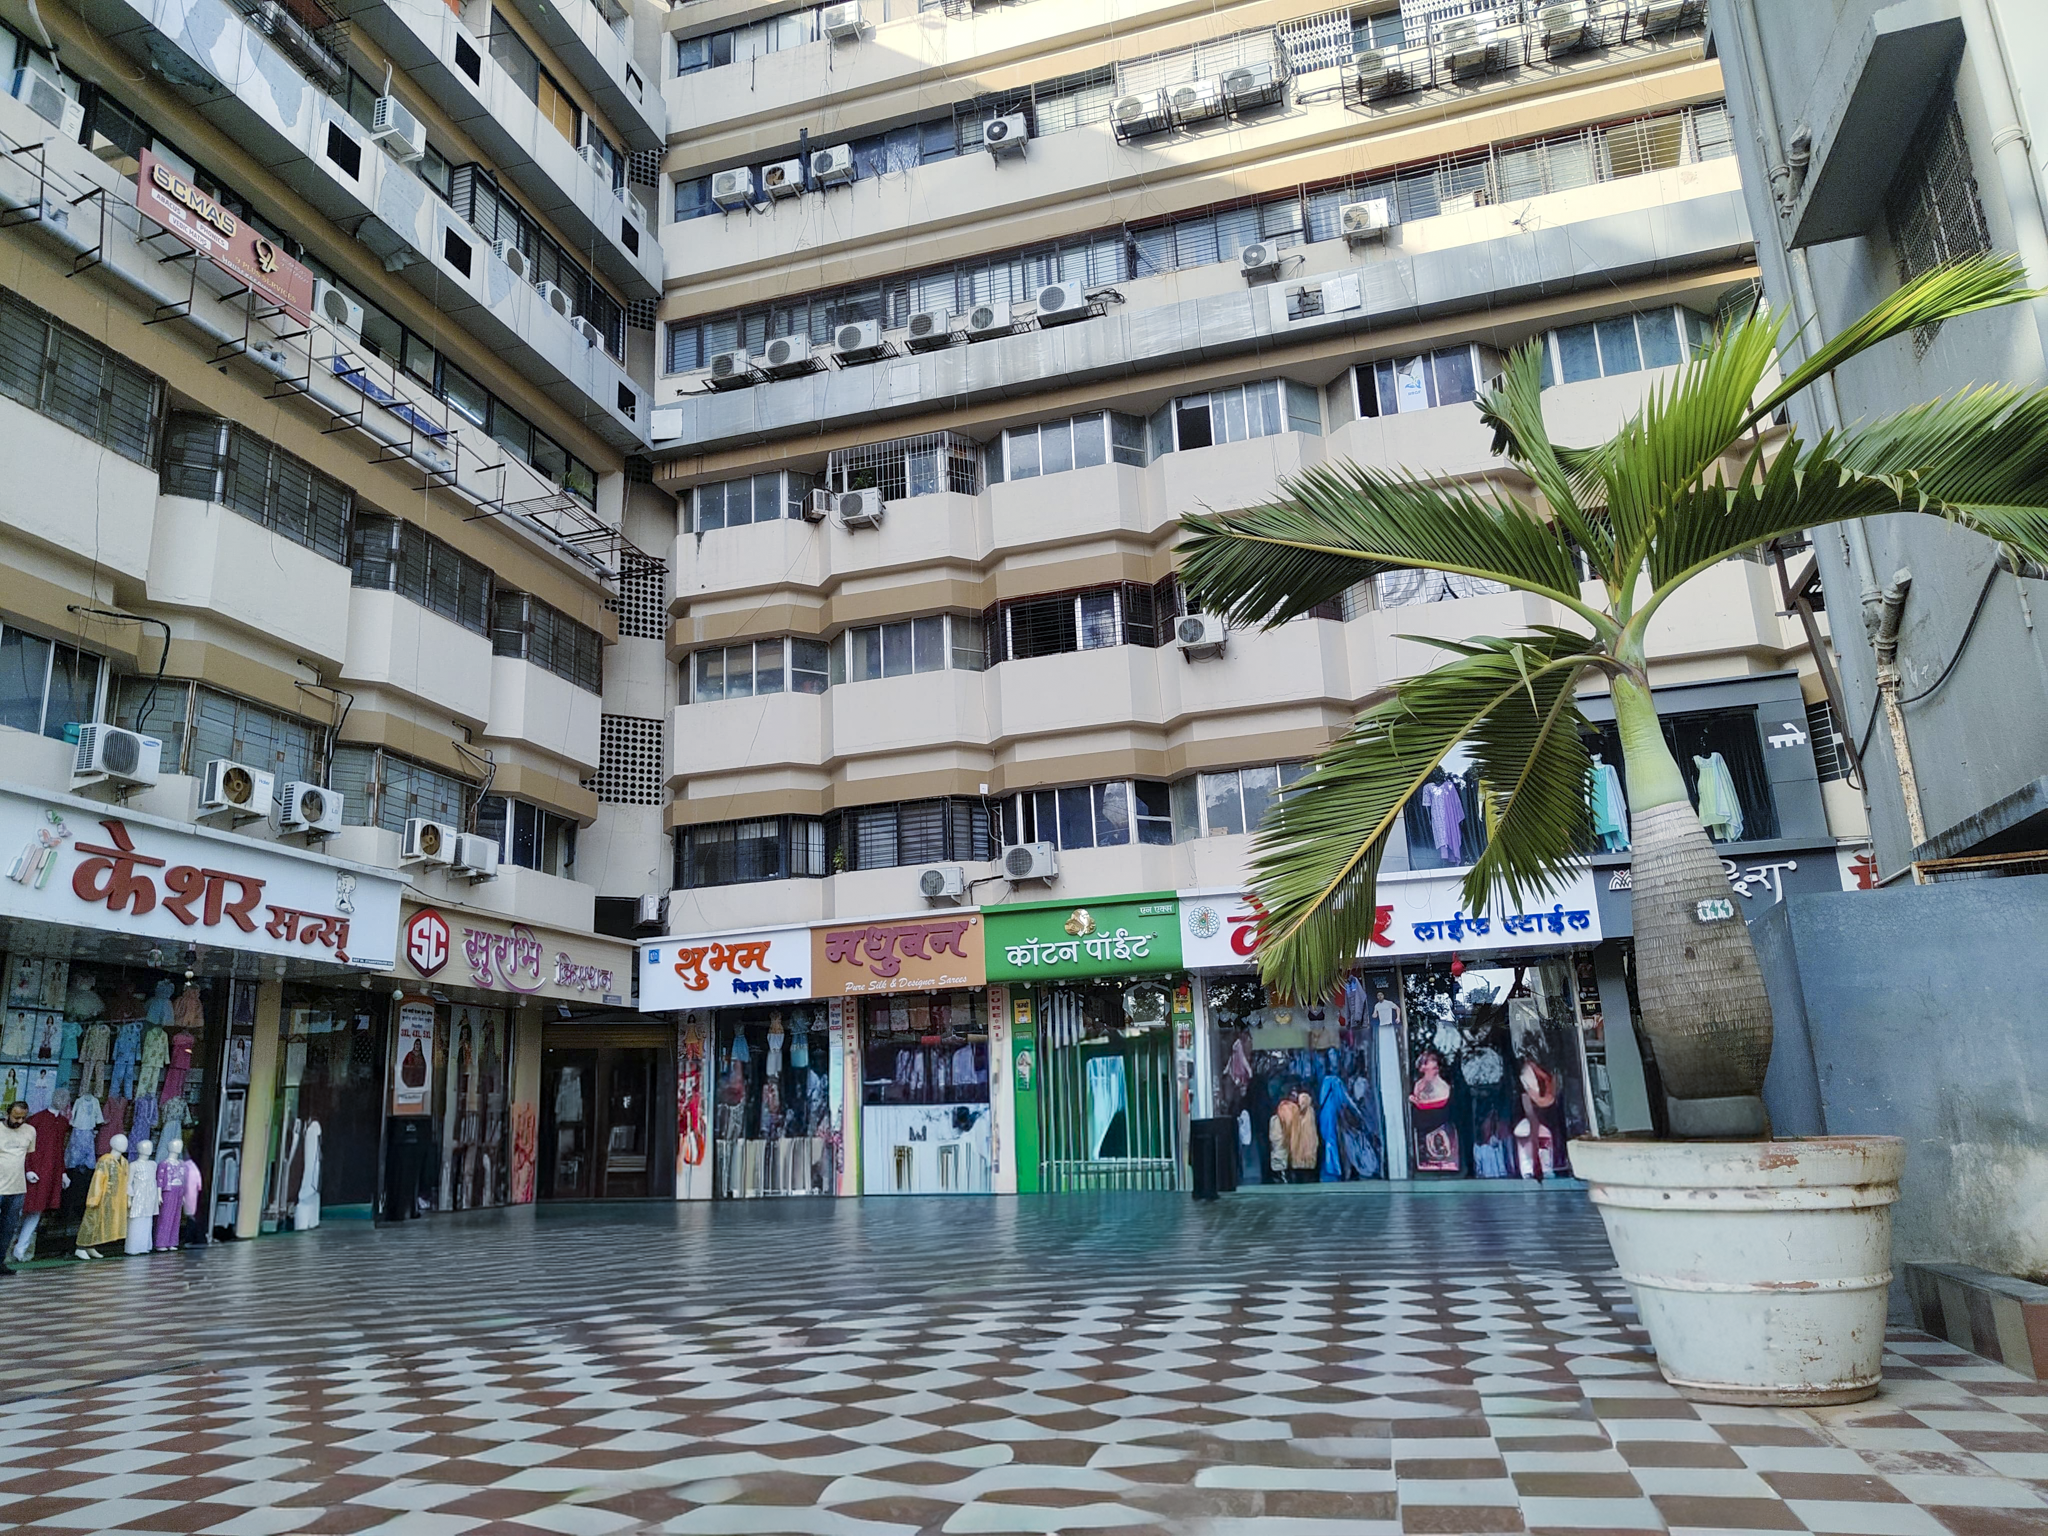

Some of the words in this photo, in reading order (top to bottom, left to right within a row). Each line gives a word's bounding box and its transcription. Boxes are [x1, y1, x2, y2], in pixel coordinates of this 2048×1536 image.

[155, 193, 182, 215] ABACUS
[199, 223, 226, 247] PHONICS
[172, 217, 189, 235] VEDIC
[189, 229, 208, 247] MATHS
[261, 274, 297, 304] SERVICES
[72, 819, 266, 934] केशर
[411, 916, 447, 970] SC
[461, 922, 547, 994] सुरभि
[674, 940, 772, 991] शुभम
[825, 920, 970, 977] मधुबन
[1004, 937, 1081, 967] कॉटन
[732, 977, 770, 998] किड्स
[772, 974, 803, 990] वेअर
[845, 981, 866, 993] Pure
[868, 979, 887, 991] Silk
[889, 978, 897, 988] &
[898, 977, 936, 990] Designer
[937, 974, 968, 986] Sarees
